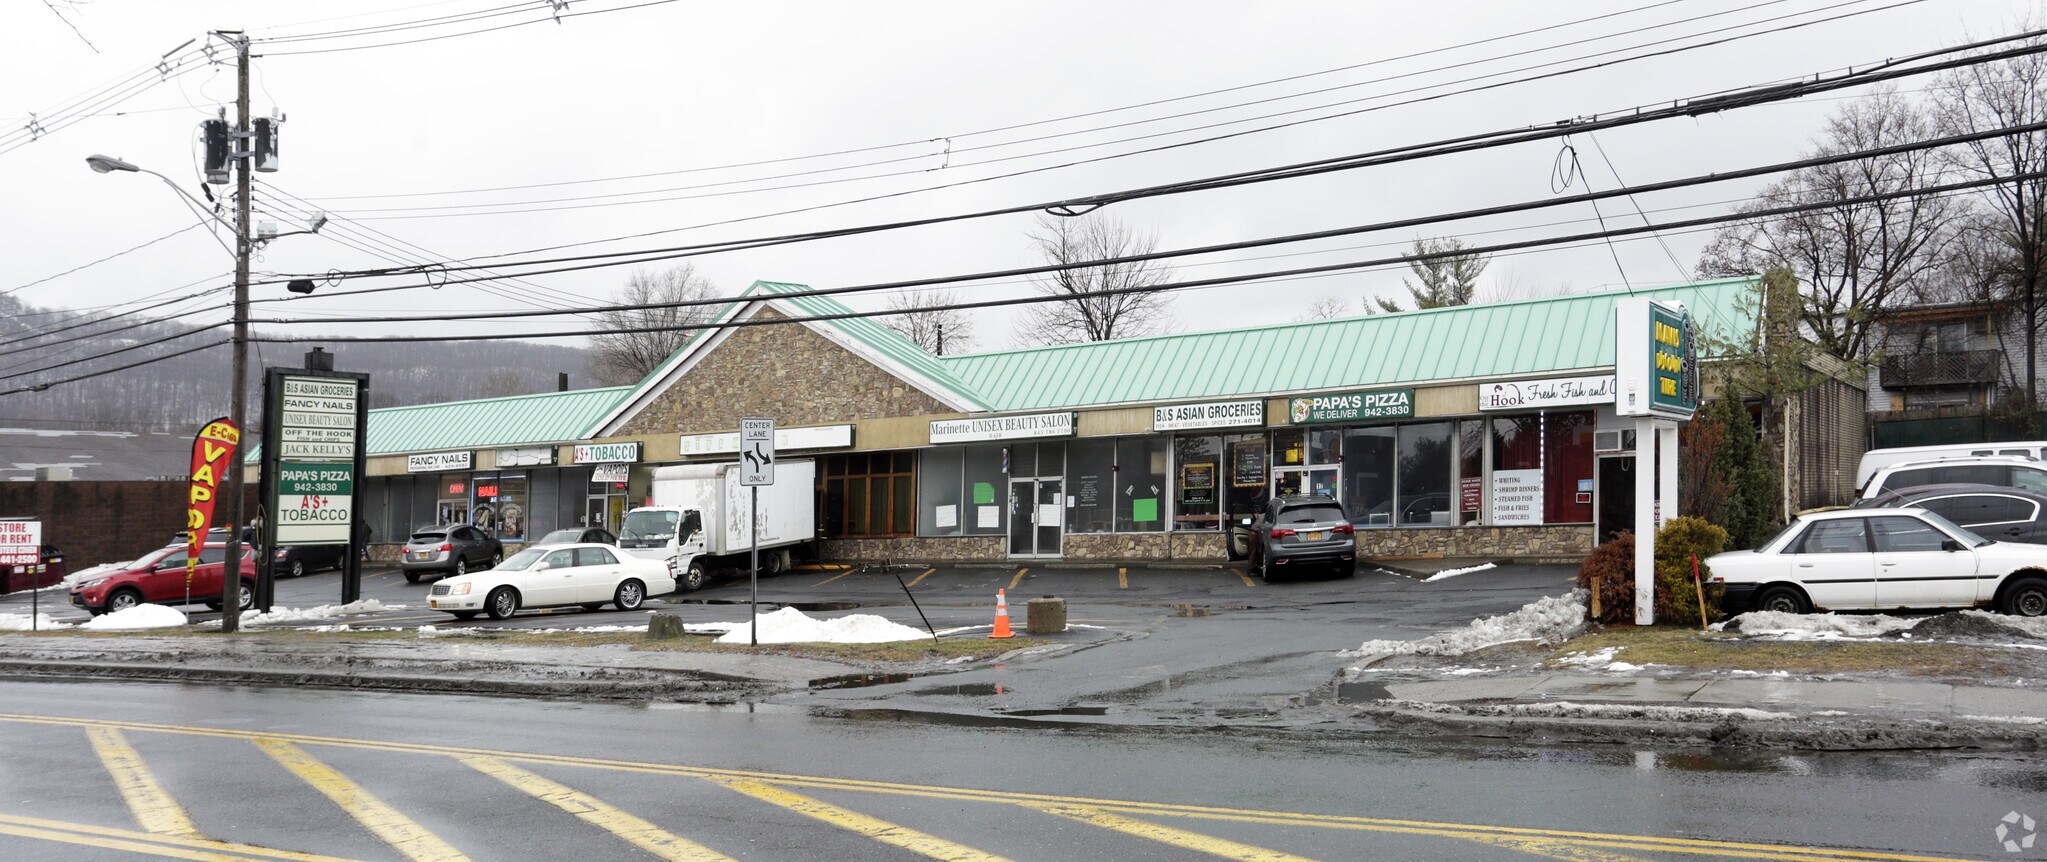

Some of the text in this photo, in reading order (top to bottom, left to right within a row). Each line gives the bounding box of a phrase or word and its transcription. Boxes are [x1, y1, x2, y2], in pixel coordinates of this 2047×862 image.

[300, 384, 319, 394] ASIAN
[320, 386, 353, 396] GROCERIES
[1528, 384, 1558, 400] Fresh
[1561, 382, 1586, 398] Fish
[1589, 380, 1607, 396] and
[1660, 377, 1676, 396] TIRE
[285, 400, 353, 410] FANCY NAILS
[1313, 392, 1408, 410] PAPA'S PIZZA
[1491, 395, 1525, 406] Hook
[1156, 403, 1261, 422] B&S ASIAN GROCERIES
[1313, 410, 1358, 419] WE DELIVER
[1365, 406, 1409, 417] 942-3830
[285, 414, 352, 426] UNISEX BEAUTY SALON
[931, 414, 1070, 435] Marinette UNISEX BEAUTY SALON
[284, 445, 351, 454] JACK KELLY'S
[589, 445, 635, 460] TOBACCO
[411, 454, 468, 465] FANCY NAILS
[282, 471, 350, 481] PAPA'S PIZZA
[294, 483, 337, 491] 942-3830
[188, 440, 226, 549] VAPOR
[281, 509, 347, 520] TOBACCO
[10, 534, 32, 543] RENT
